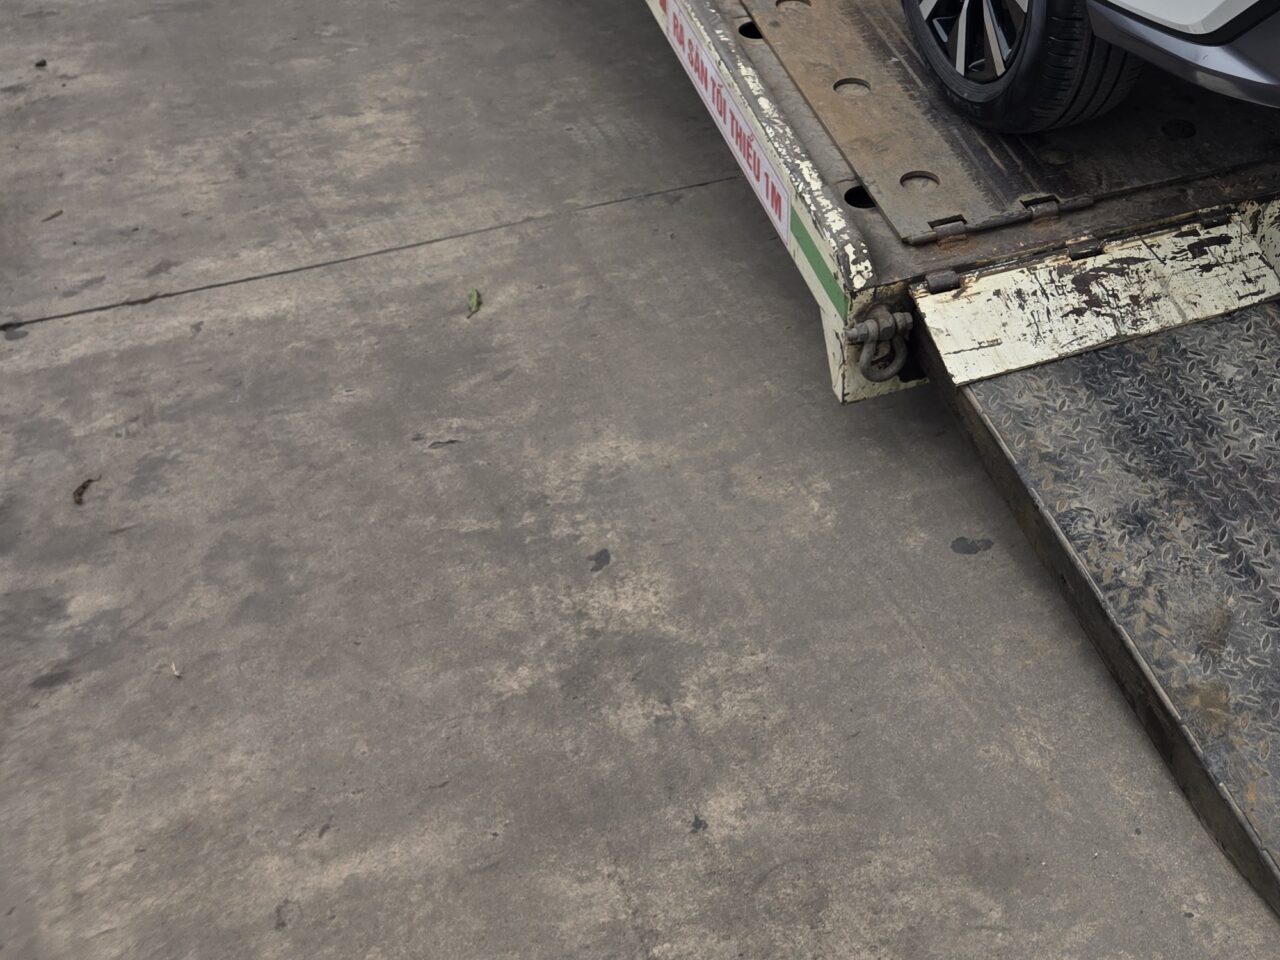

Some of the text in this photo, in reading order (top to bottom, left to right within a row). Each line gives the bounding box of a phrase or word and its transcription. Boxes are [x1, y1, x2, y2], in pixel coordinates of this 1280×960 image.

[710, 76, 727, 125] TỐI
[728, 107, 761, 183] THIỂU
[764, 171, 783, 222] 1M
